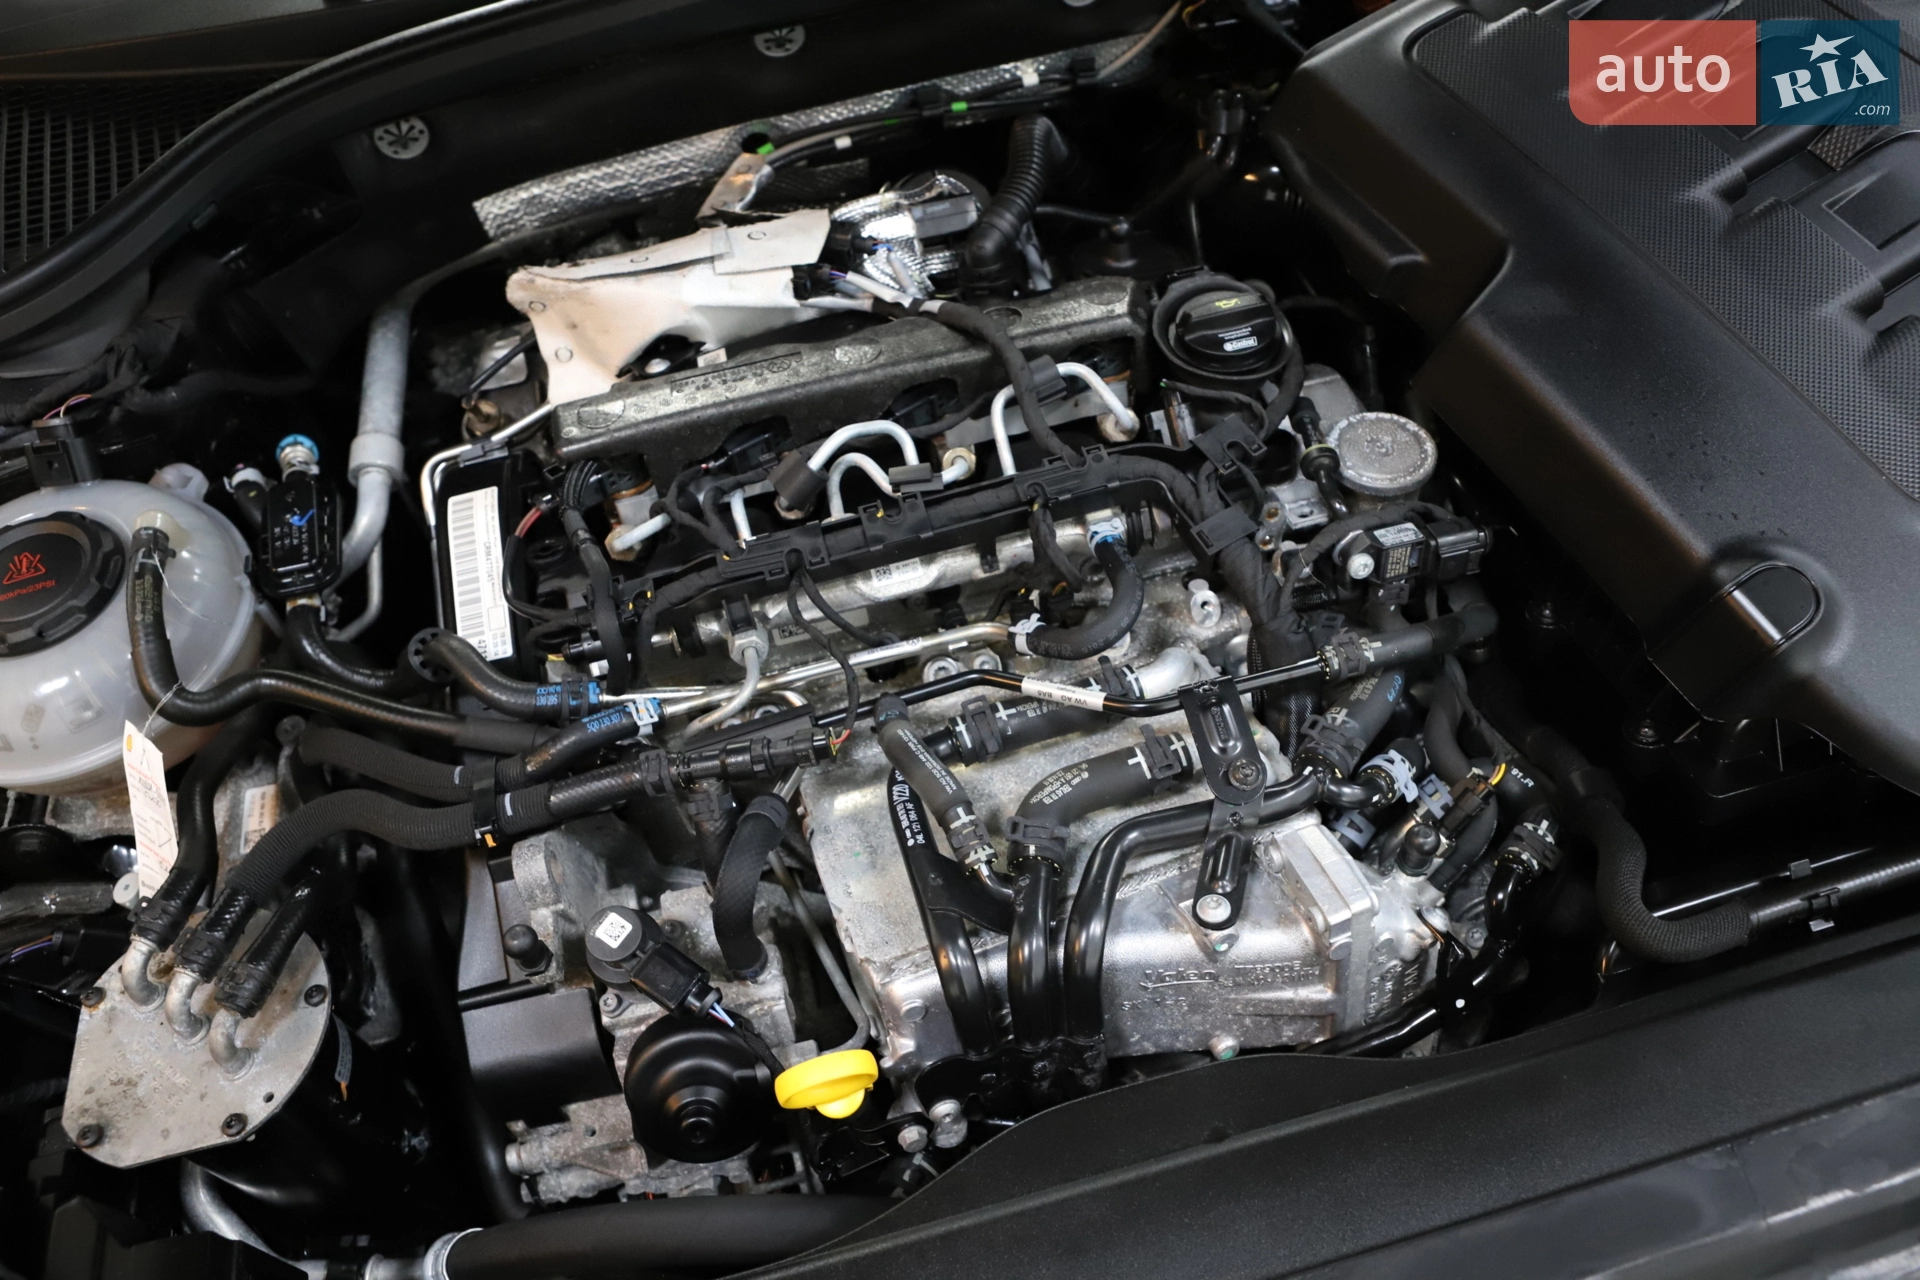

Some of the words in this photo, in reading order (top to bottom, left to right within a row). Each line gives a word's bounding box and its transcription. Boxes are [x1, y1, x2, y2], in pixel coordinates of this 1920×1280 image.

[600, 716, 610, 728] 130
[923, 752, 942, 771] ROMANIA
[925, 761, 933, 770] 122
[939, 777, 948, 787] AG
[944, 775, 957, 789] MADE
[944, 784, 953, 794] VW
[892, 786, 909, 805] V220
[913, 822, 921, 831] 121
[916, 833, 925, 843] 04L
[1144, 968, 1216, 985] Valeo
